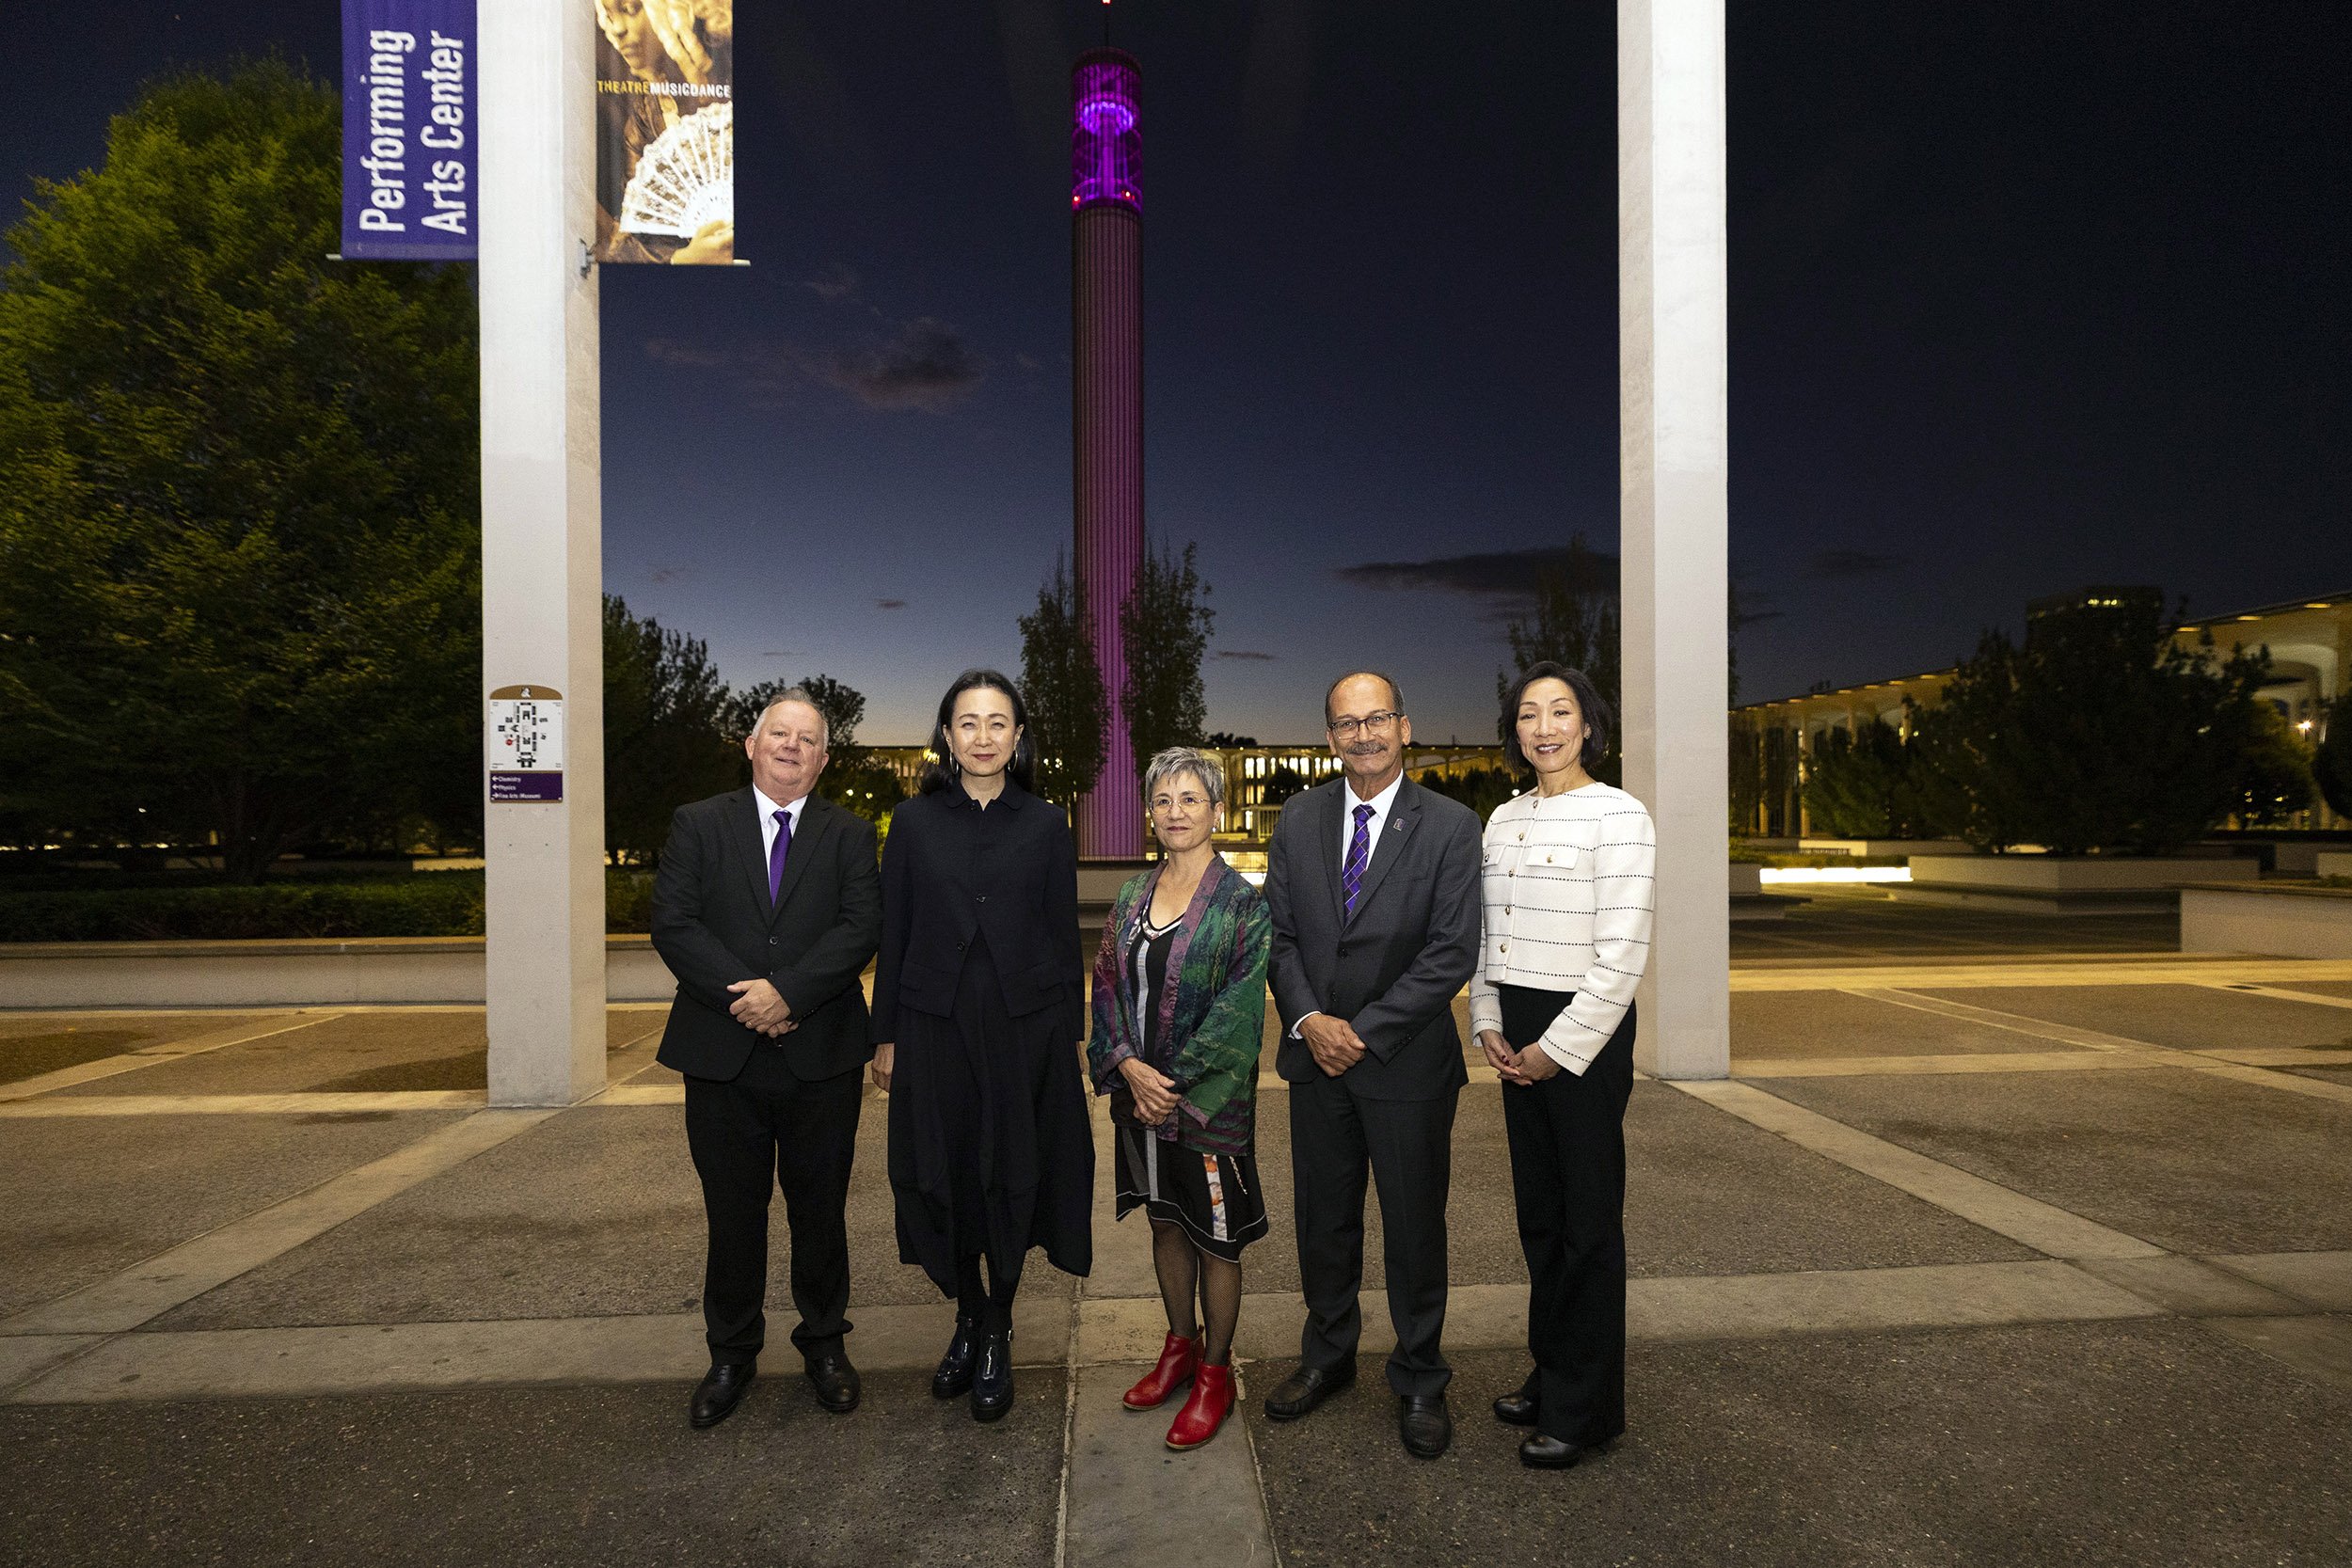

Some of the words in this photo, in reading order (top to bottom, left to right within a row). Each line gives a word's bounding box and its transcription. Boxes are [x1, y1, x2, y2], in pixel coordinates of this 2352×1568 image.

[359, 30, 416, 232] Performing
[420, 30, 465, 150] Center
[421, 160, 467, 235] Arts
